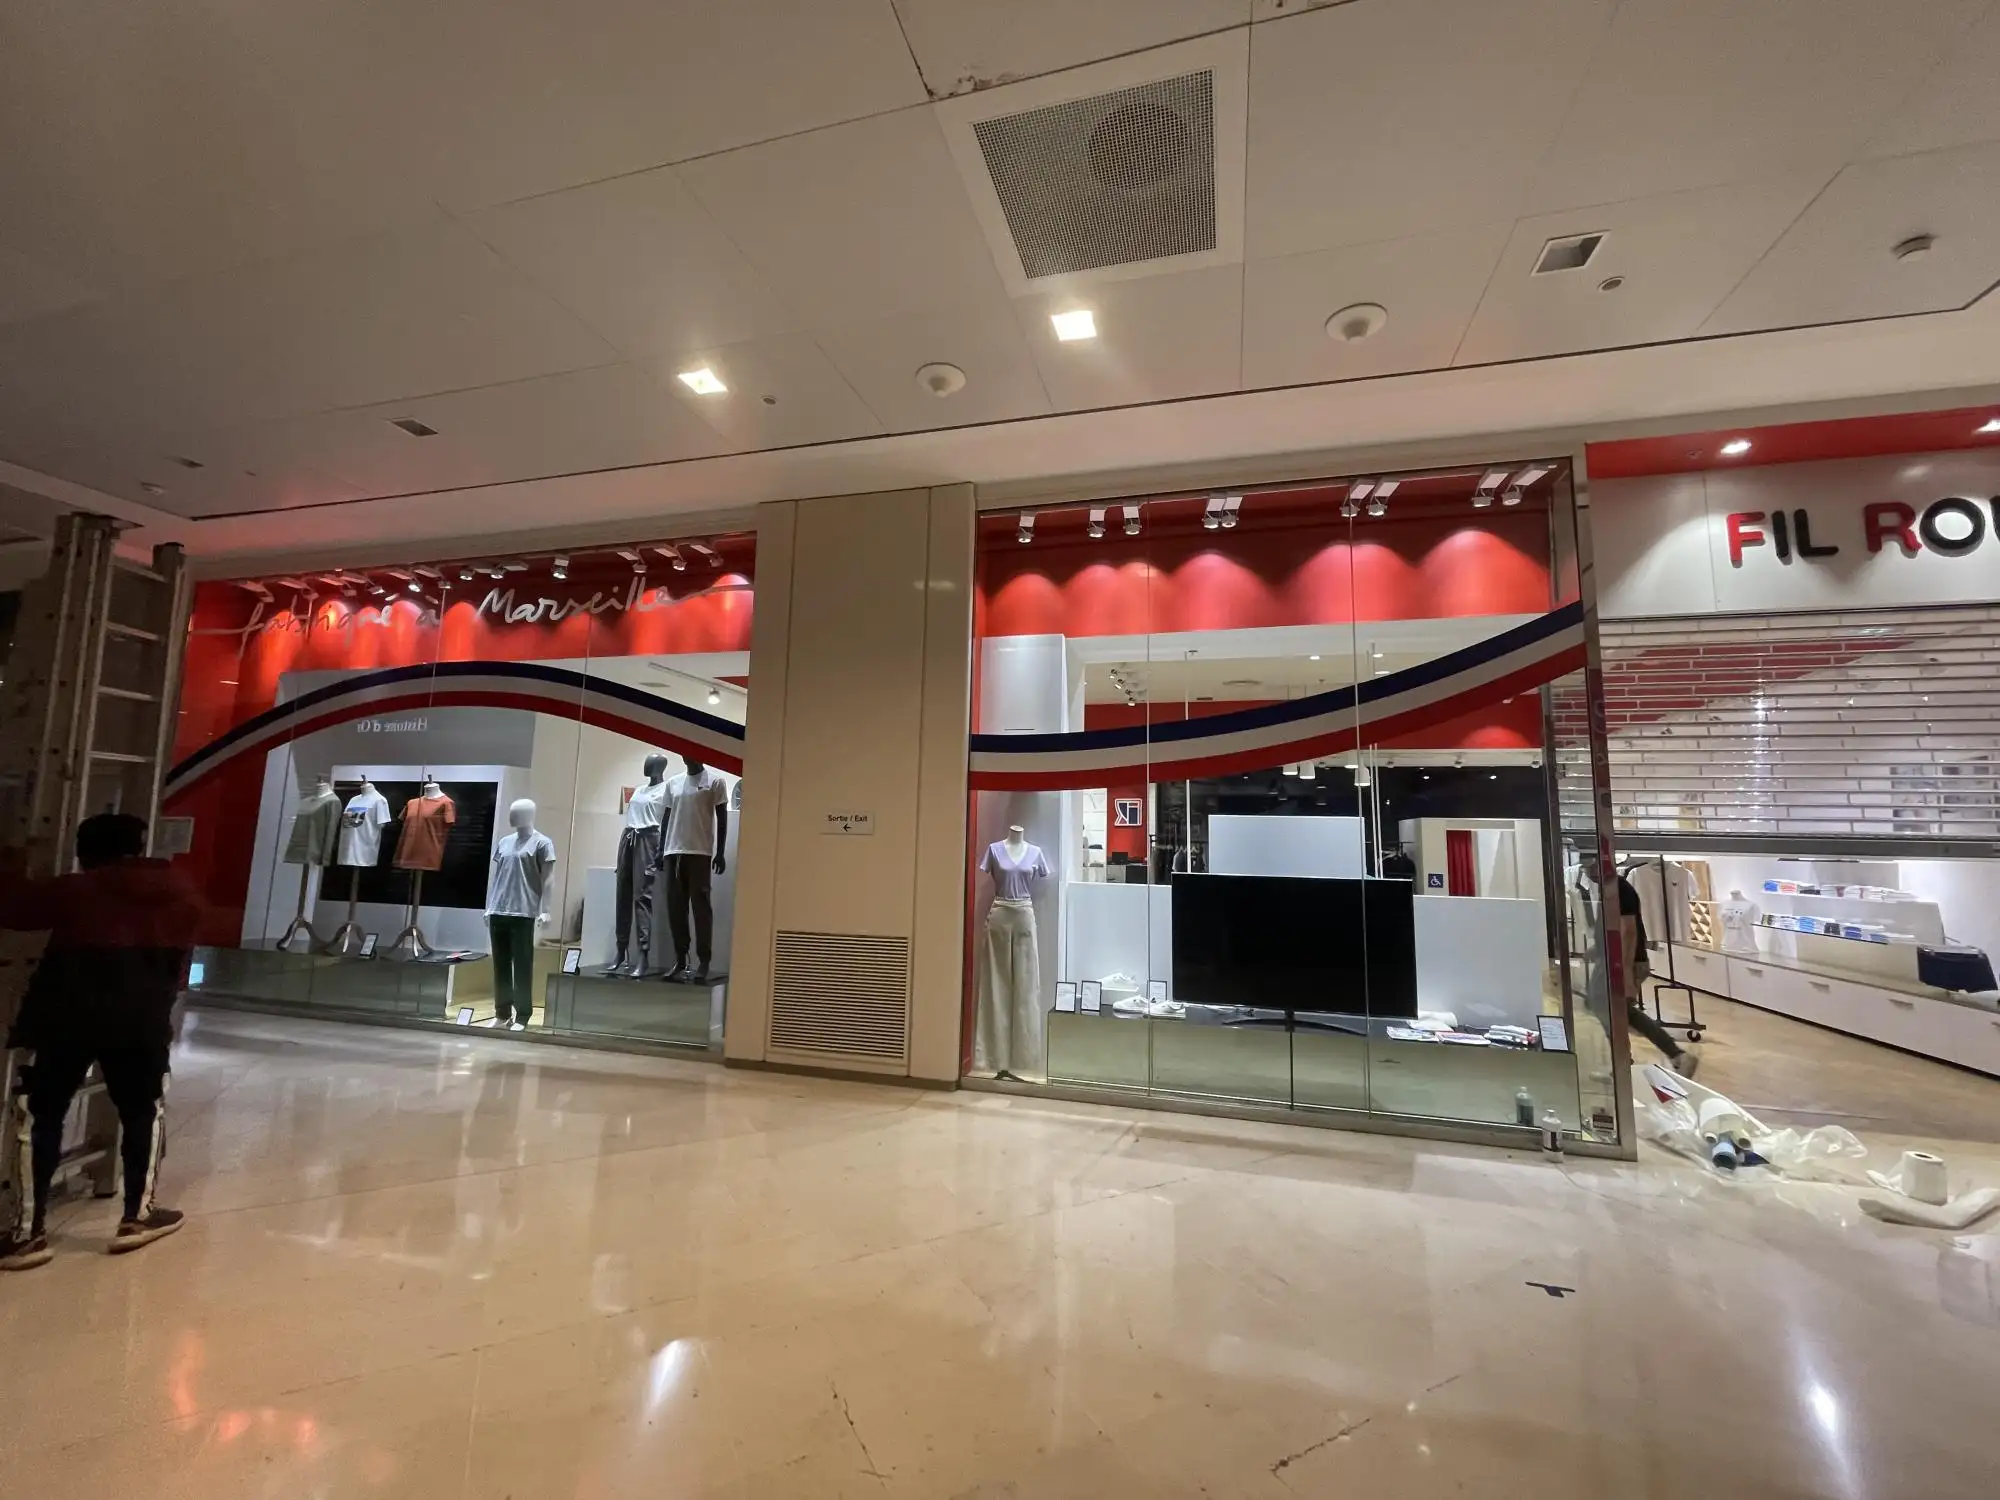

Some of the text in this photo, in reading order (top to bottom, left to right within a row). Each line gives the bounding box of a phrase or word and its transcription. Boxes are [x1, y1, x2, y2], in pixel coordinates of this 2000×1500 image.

[1726, 508, 1840, 563] FIL
[474, 576, 750, 624] Marseille
[827, 814, 848, 822] Sortie
[854, 814, 868, 822] Exit
